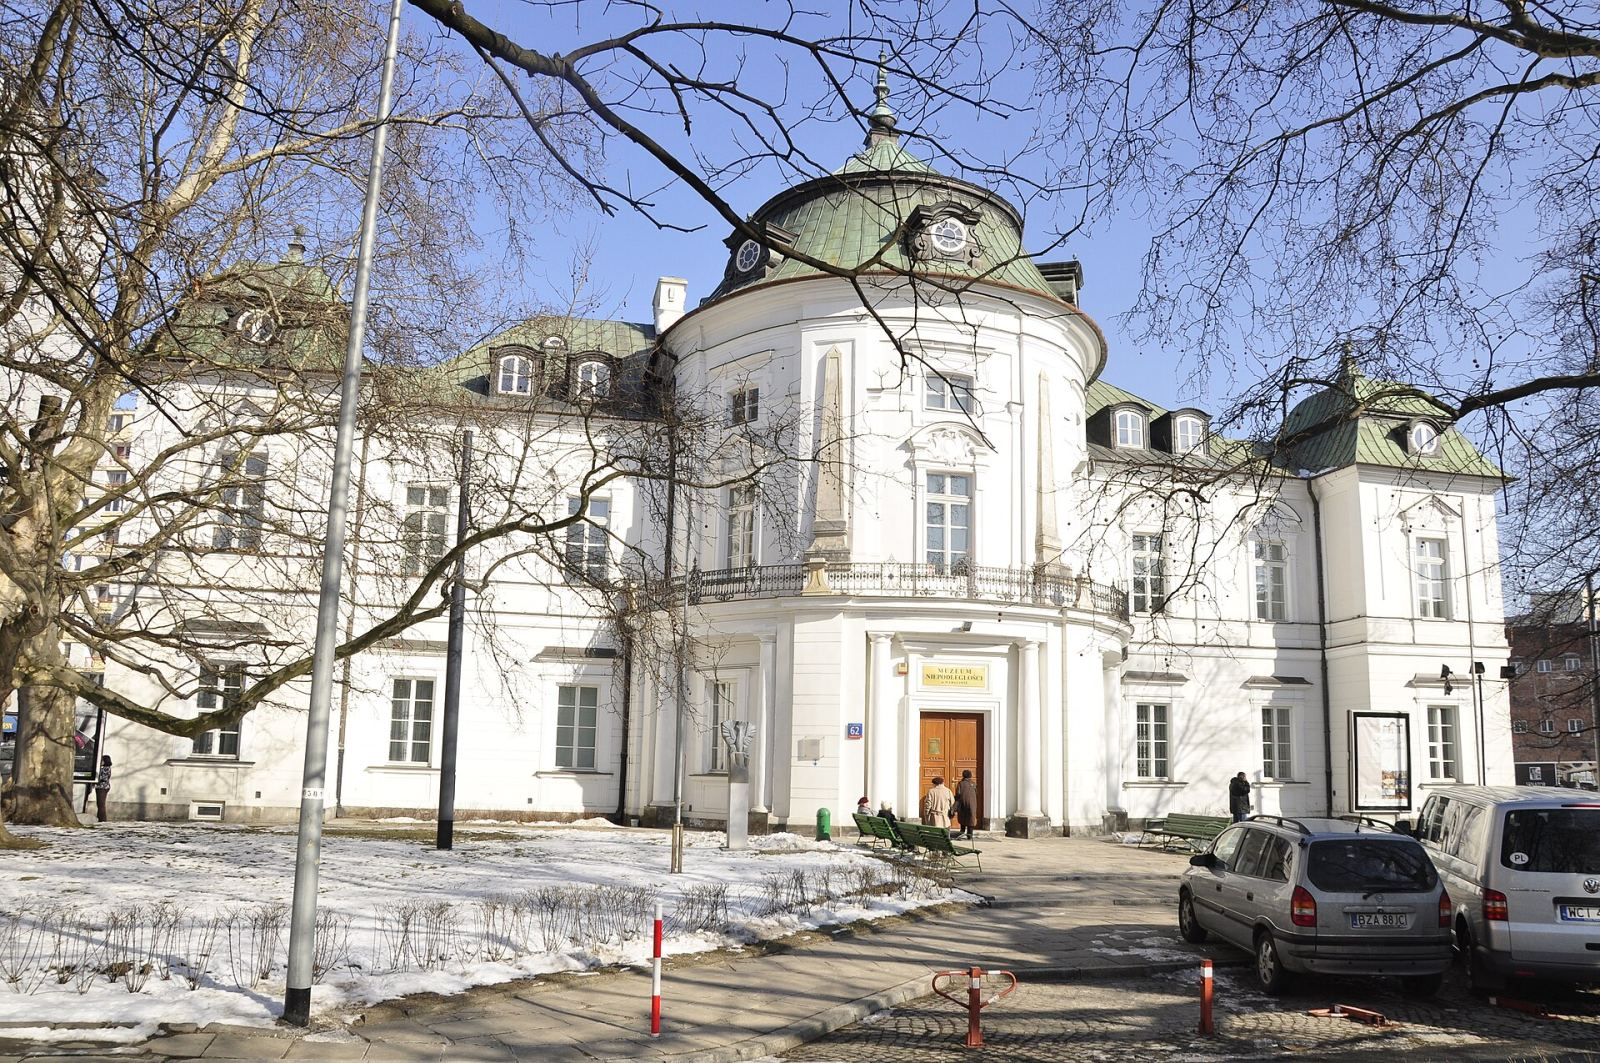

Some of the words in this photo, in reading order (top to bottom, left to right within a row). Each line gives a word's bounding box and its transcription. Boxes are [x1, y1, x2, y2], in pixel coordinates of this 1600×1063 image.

[937, 667, 972, 675] MUZEUM
[850, 726, 860, 735] 62
[1514, 854, 1526, 862] PL
[1568, 907, 1590, 918] WCI
[1358, 914, 1380, 925] BZA
[1382, 914, 1405, 925] 88JC
